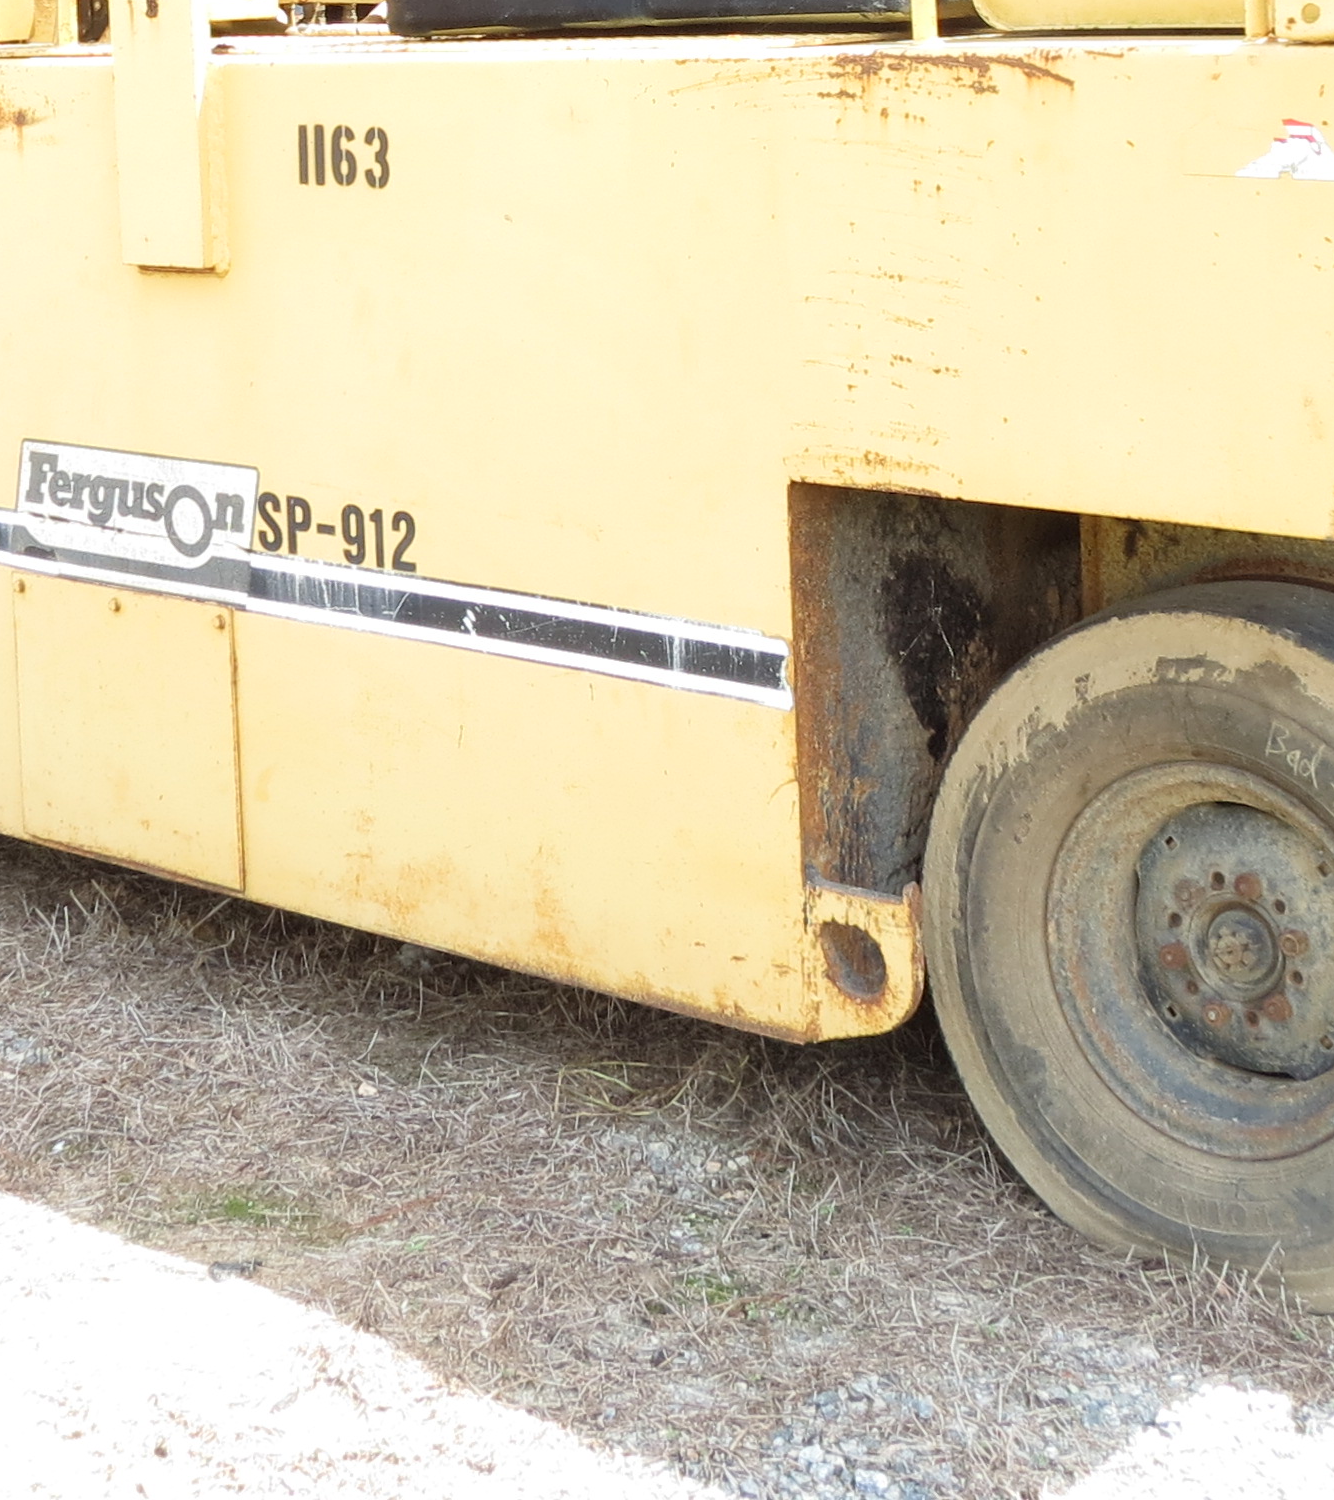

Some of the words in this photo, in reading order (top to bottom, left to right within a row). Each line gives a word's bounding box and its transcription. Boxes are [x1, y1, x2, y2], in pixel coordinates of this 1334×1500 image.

[298, 124, 390, 189] 1163
[258, 491, 418, 573] SP-912
[1264, 720, 1325, 789] Bad
